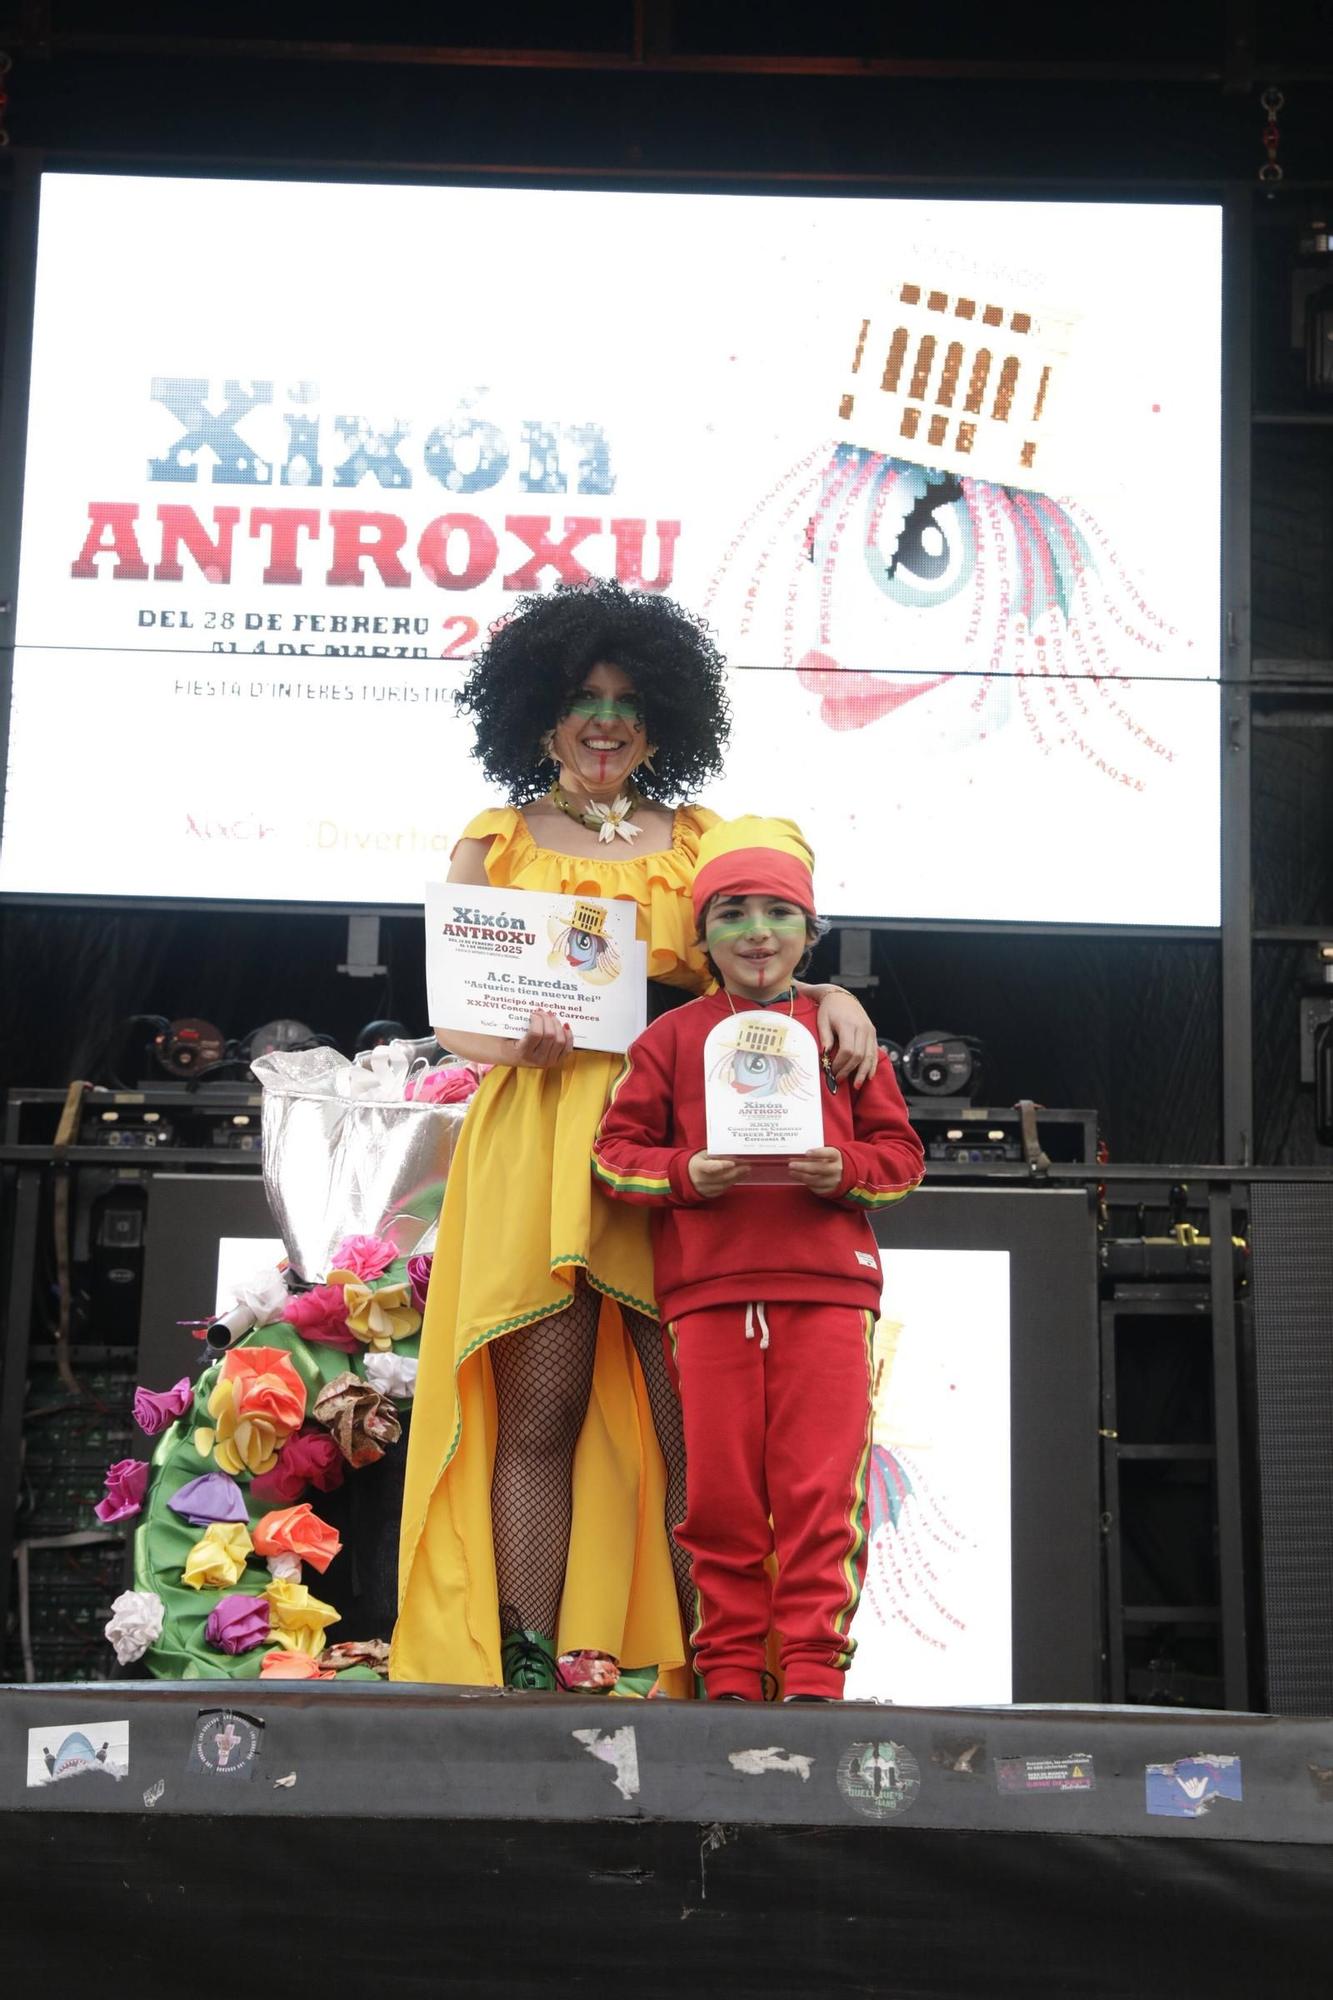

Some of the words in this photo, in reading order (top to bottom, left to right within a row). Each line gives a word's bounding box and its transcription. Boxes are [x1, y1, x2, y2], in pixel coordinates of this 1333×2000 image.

[147, 377, 617, 495] Xixón
[70, 502, 681, 593] ANTROXU
[138, 609, 193, 628] DEL
[204, 612, 235, 630] 28
[245, 613, 282, 631] DE
[292, 614, 429, 635] FEBRERU
[453, 906, 526, 930] Xixón
[442, 923, 536, 945] ANTROXU
[494, 944, 523, 955] 2025
[487, 971, 515, 984] A.C.
[518, 975, 578, 992] Enredas
[483, 994, 527, 1006] Participó
[567, 1004, 582, 1012] nel
[518, 986, 539, 997] tien
[541, 991, 576, 1001] nuevu
[466, 999, 499, 1009] XXXVI
[559, 1010, 601, 1022] Carroces
[743, 1101, 783, 1109] Xixón
